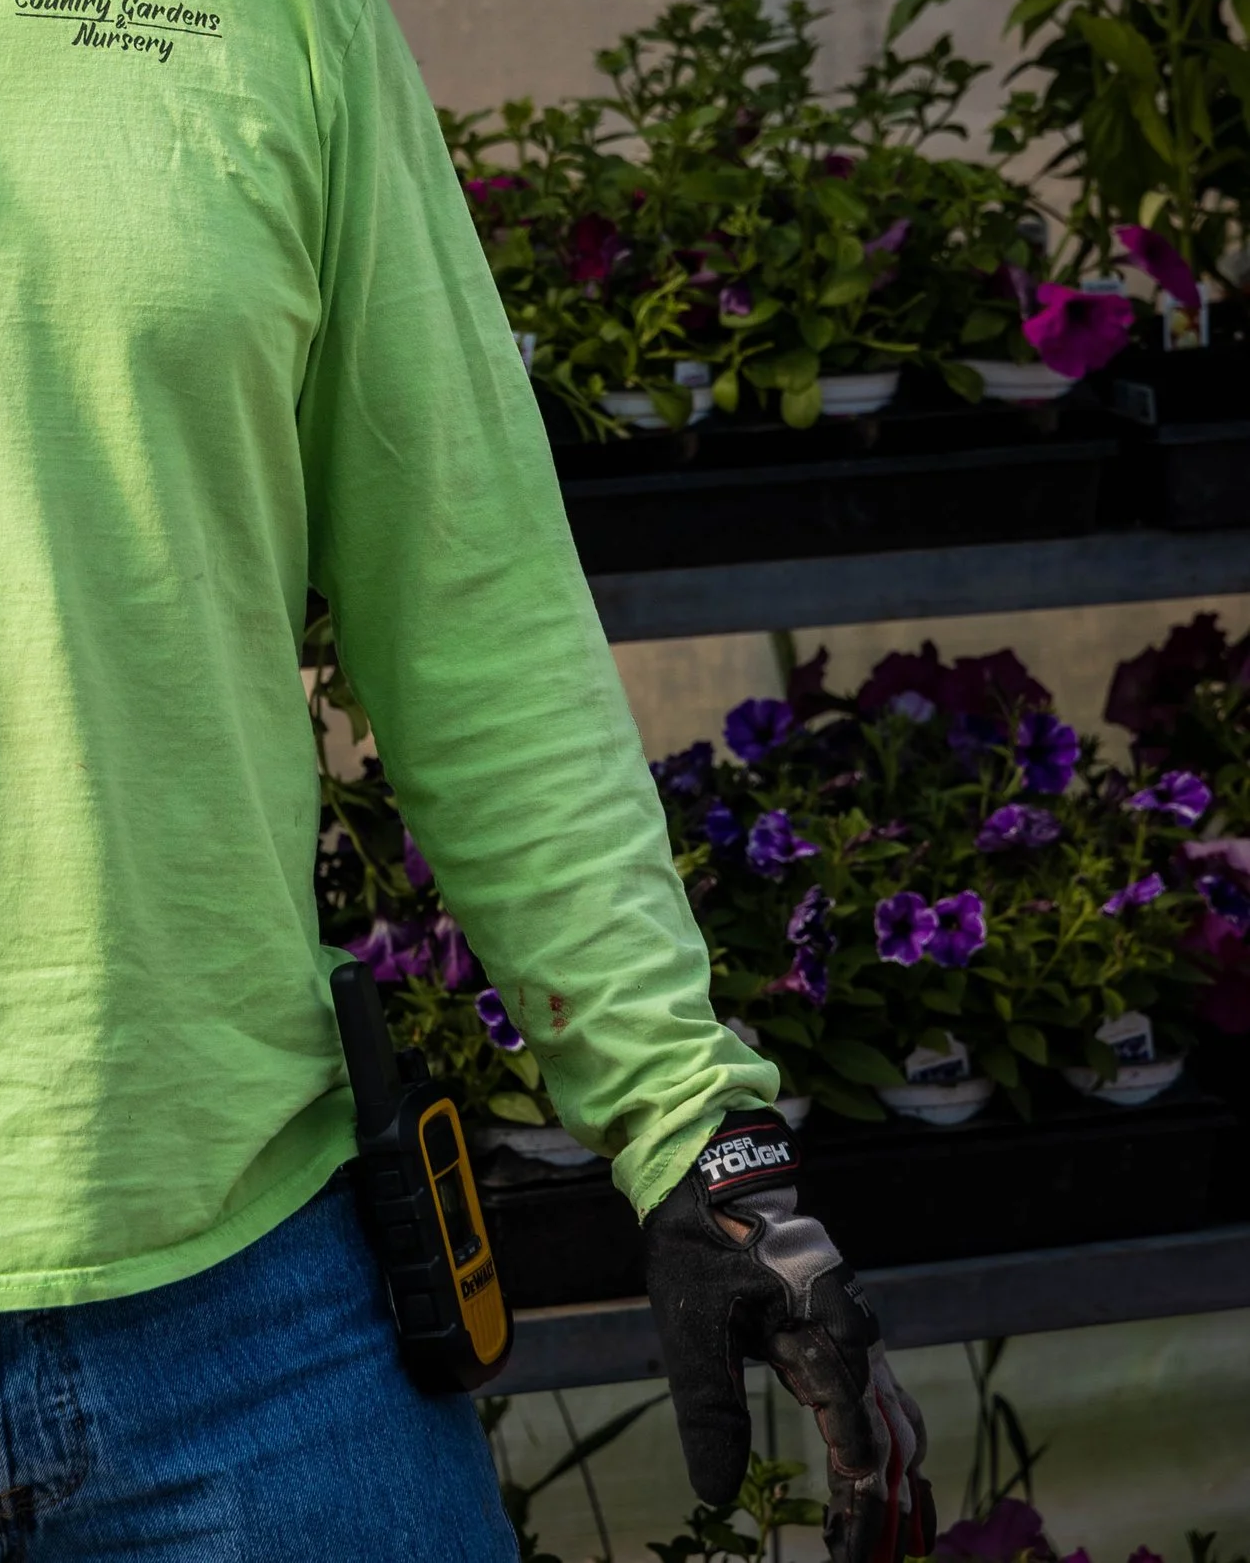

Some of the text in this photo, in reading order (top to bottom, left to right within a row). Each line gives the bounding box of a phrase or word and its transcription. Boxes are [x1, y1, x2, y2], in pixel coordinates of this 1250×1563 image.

[115, 14, 128, 29] &
[71, 21, 174, 63] Nursery
[698, 1137, 754, 1165] HYPER
